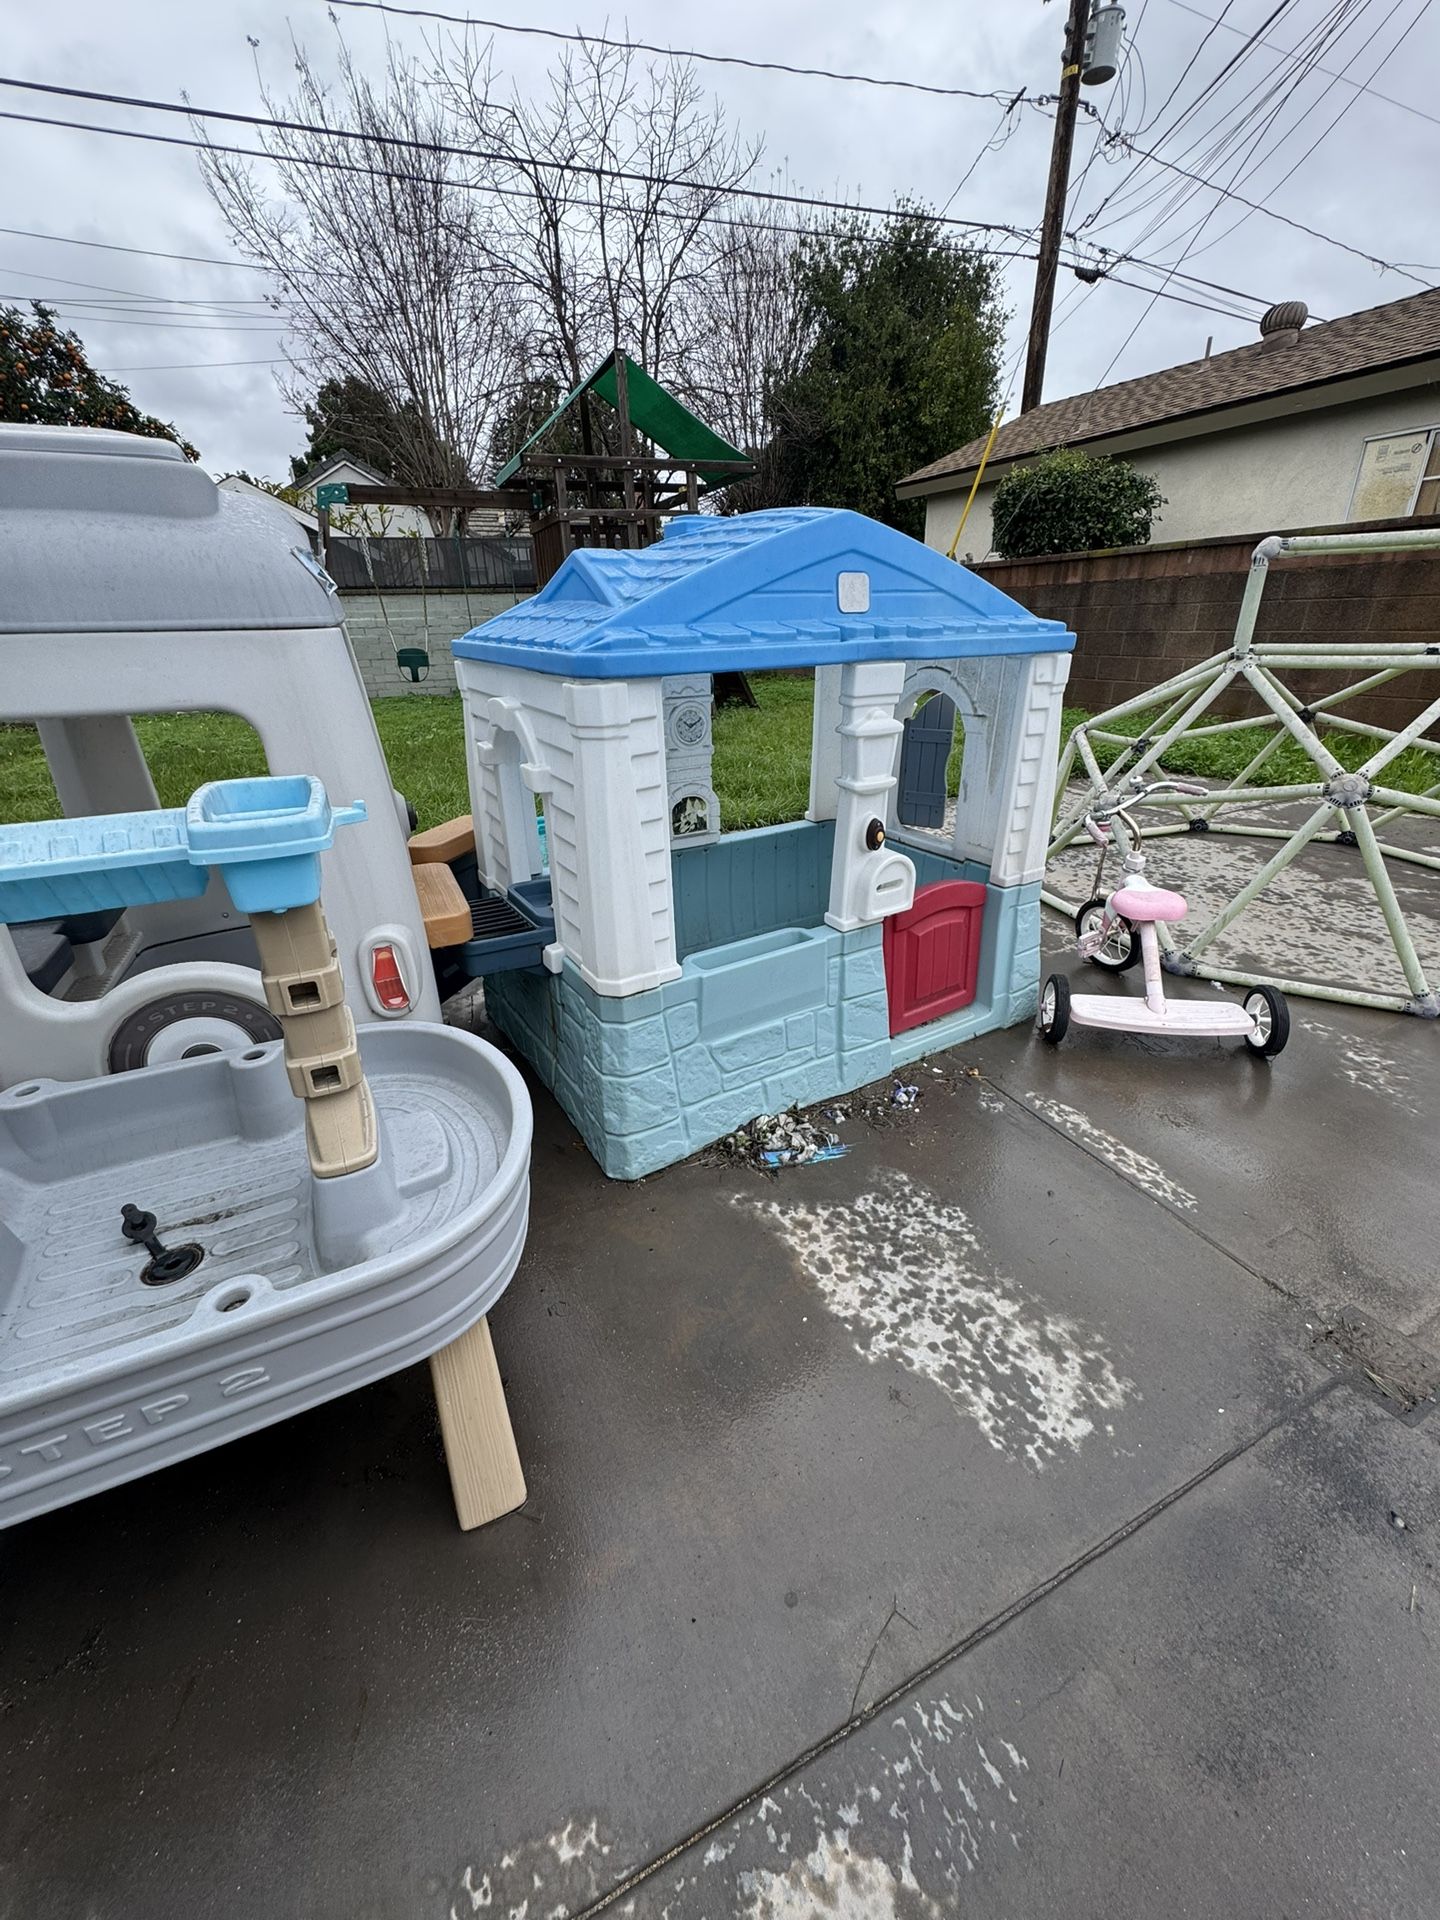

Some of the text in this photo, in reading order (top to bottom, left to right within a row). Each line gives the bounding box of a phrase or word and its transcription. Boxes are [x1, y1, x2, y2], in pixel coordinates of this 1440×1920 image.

[149, 1002, 239, 1022] STEP 2
[0, 1367, 271, 1480] TEP 2
